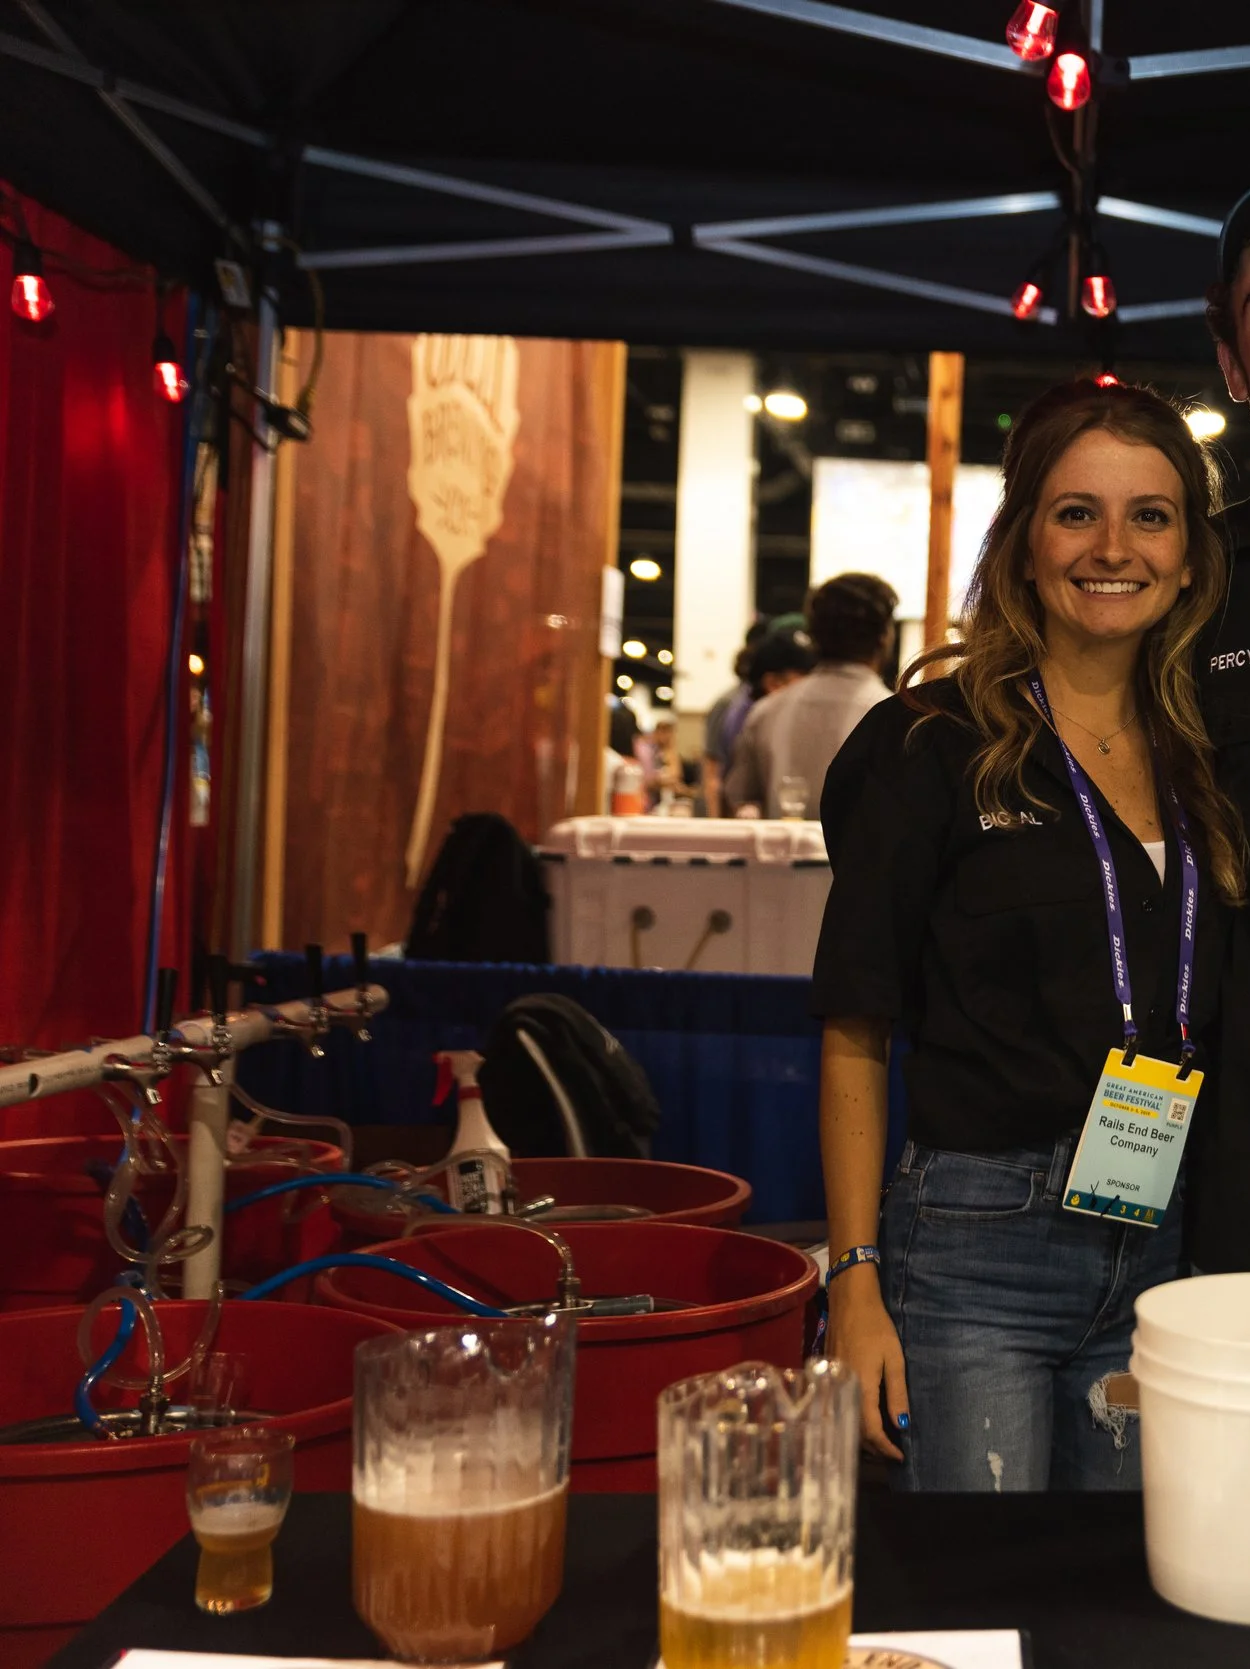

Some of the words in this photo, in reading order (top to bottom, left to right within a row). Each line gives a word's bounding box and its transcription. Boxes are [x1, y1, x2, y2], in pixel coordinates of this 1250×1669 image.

[978, 811, 1012, 831] BIG
[1020, 811, 1043, 825] AL
[1079, 791, 1102, 840] Dickies
[1102, 859, 1116, 912] Dickies
[1184, 887, 1196, 942] Dickies
[1112, 934, 1125, 989] Dickies
[1180, 962, 1191, 1014] Dickies
[1103, 1089, 1125, 1100] BEER
[1125, 1094, 1161, 1111] FESTIVAL
[1106, 1081, 1127, 1092] GREAT
[1128, 1088, 1164, 1101] AMERICAN
[1099, 1115, 1125, 1132] Rails
[1127, 1122, 1149, 1137] End
[1150, 1128, 1175, 1144] Beer
[1110, 1135, 1159, 1158] Company
[1106, 1178, 1141, 1193] SPONSOR
